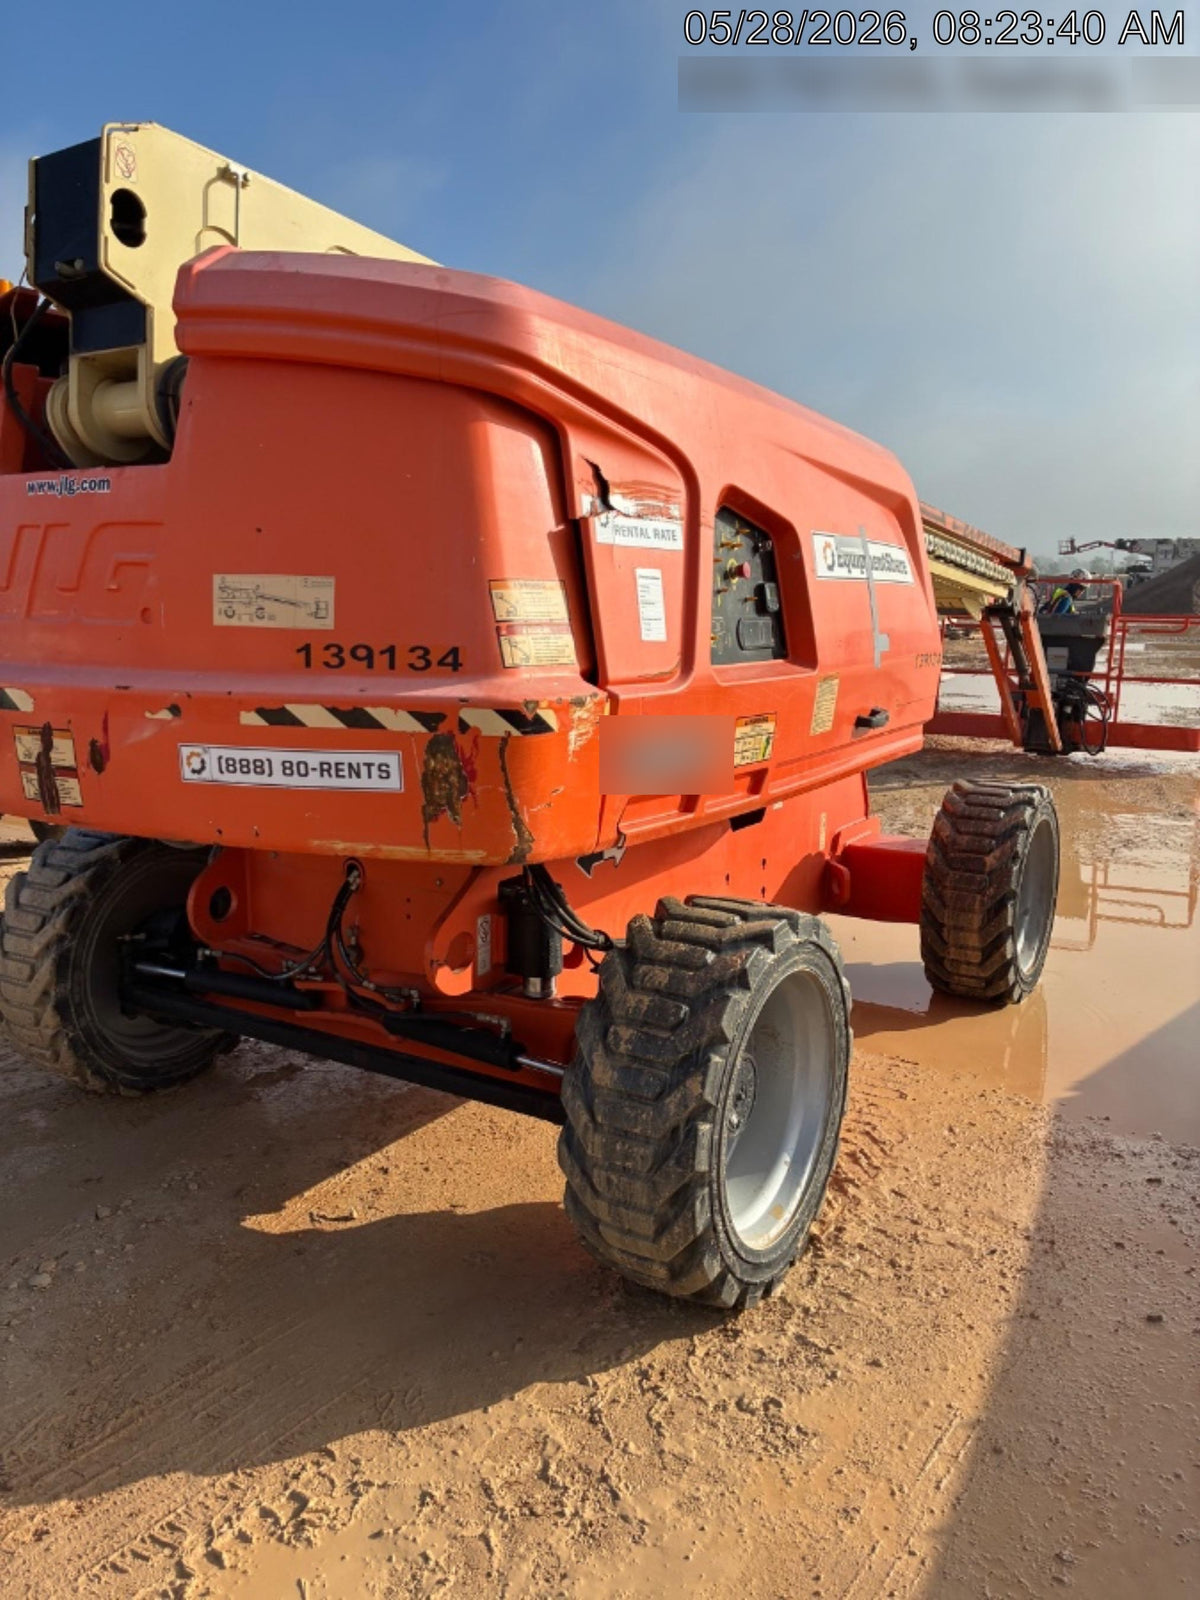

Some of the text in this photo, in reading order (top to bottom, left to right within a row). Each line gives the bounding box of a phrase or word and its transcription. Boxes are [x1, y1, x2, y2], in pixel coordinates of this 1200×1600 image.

[26, 475, 111, 497] www.jlg.com
[614, 524, 678, 542] RENTAL RATE
[296, 642, 464, 672] 139134
[217, 755, 392, 780] (888) 80-RENTS
